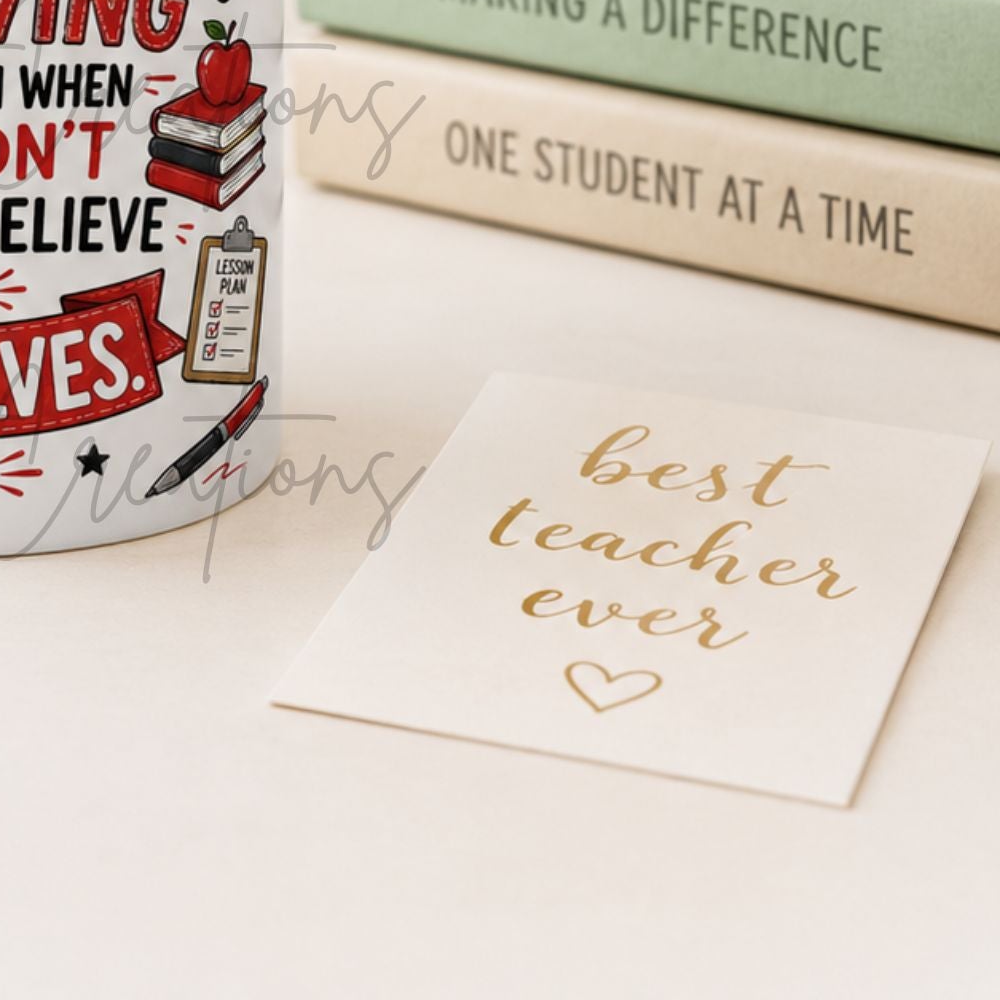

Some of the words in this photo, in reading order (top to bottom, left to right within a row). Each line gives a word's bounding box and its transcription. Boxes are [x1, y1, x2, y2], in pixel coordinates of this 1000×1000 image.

[19, 63, 134, 109] WHEN
[443, 120, 520, 174] ONE
[532, 134, 702, 213] STUDENT
[715, 175, 763, 225] AT
[776, 187, 806, 233] A
[817, 194, 914, 256] TIME
[215, 258, 255, 276] LESSON
[219, 277, 248, 296] PLAN
[579, 425, 830, 508] best
[488, 497, 858, 600] teacher
[520, 588, 750, 650] ever
